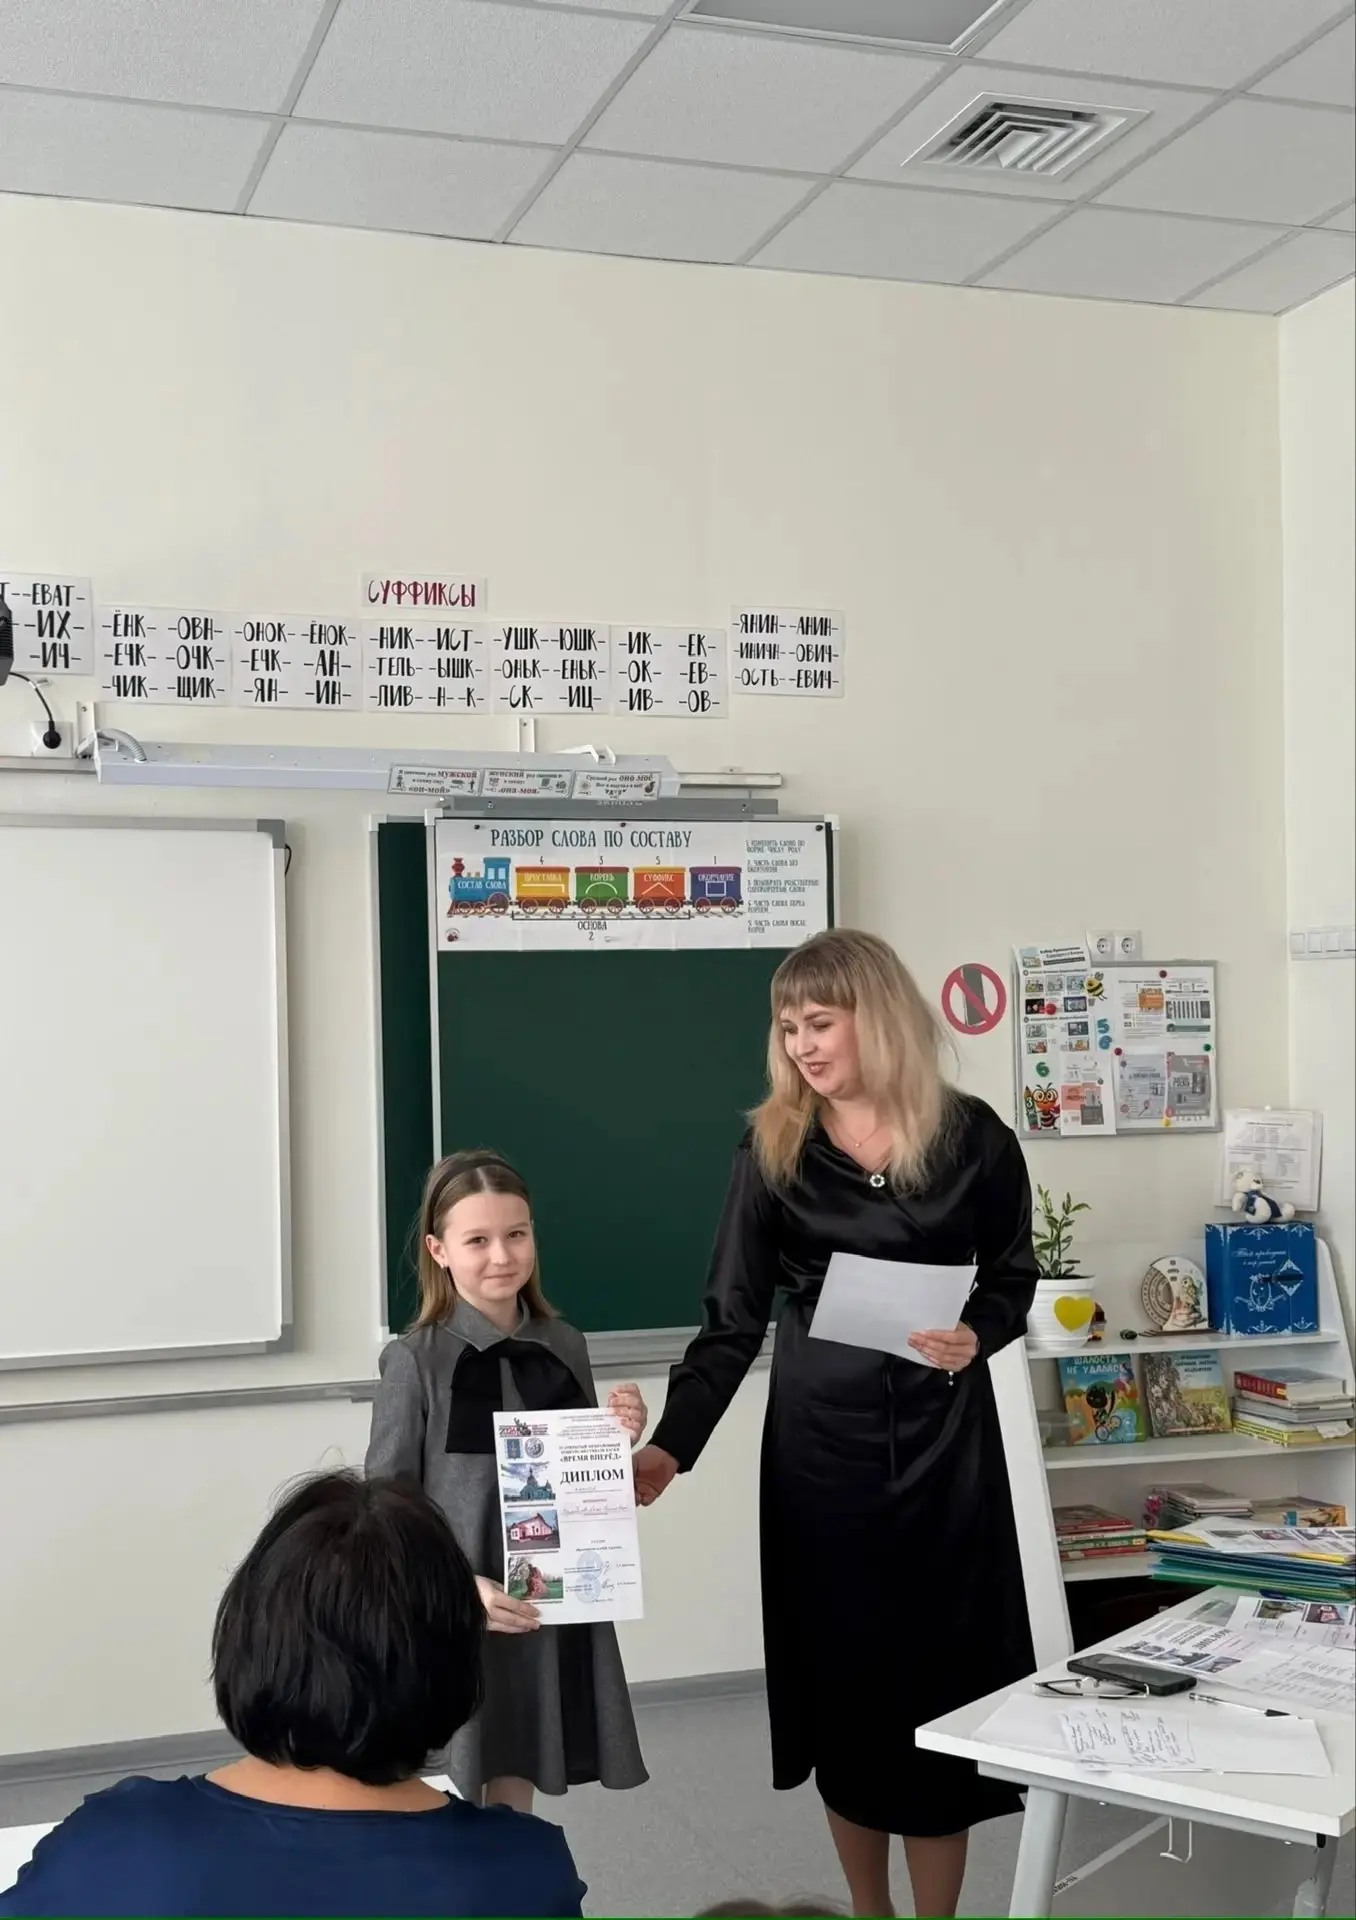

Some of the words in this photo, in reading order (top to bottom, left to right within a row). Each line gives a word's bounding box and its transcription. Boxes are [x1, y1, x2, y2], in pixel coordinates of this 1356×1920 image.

[368, 580, 476, 607] СУФФИКСЫ
[24, 609, 84, 640] -ИХ-
[168, 616, 223, 640] -ОВН-
[234, 622, 296, 643] -ОНОК-
[732, 613, 786, 634] -ЯНИН-
[789, 616, 839, 636] -АНИН-
[369, 626, 424, 650] -НИК-
[427, 627, 483, 651] -ИСТ-
[493, 626, 549, 650] -УШК-
[551, 628, 606, 652] -ЮШК-
[618, 631, 662, 655] -ИК-
[678, 633, 716, 657] -ЕК-
[29, 642, 82, 668] -ИЧ-
[104, 643, 156, 667] -ЕЧК-
[165, 644, 225, 670] -ОЧК-
[240, 649, 291, 672] -ЕЧК-
[304, 649, 351, 677] -АН-
[788, 643, 839, 663] -ОВИЧ-
[369, 657, 423, 676] -ТЕЛЬ-
[429, 657, 483, 679] -ЫШК-
[494, 659, 549, 679] -ОНЬК-
[553, 659, 606, 680] -ЕНЬК-
[618, 660, 662, 683] -ОК-
[680, 661, 717, 684] -ЕВ-
[734, 668, 785, 687] -ОСТЬ-
[788, 669, 839, 689] -ЕВИЧ-
[102, 675, 158, 698] -ЧИК-
[167, 676, 225, 701] -ЩИК-
[243, 677, 288, 702] -ЯН-
[305, 680, 351, 705] -ИН-
[369, 685, 423, 707] -ЛИВ-
[500, 684, 543, 709] -СК-
[559, 685, 602, 711] -ИЦ-
[619, 688, 663, 711] -ИВ-
[679, 689, 720, 713] -ОВ-
[490, 829, 544, 847] РАЗБОР
[552, 830, 596, 847] СЛОВА
[604, 830, 623, 847] ПО
[630, 830, 692, 848] СОСТАВУ
[539, 855, 544, 865] 4
[599, 855, 604, 865] 3
[656, 855, 661, 865] 5
[457, 880, 482, 889] СОСТАВ
[485, 880, 507, 889] СЛОВА
[590, 873, 615, 882] КОРЕНЬ
[643, 873, 675, 882] СУФФИКС
[577, 920, 607, 931] ОСНОВА
[588, 932, 594, 941] 2
[1035, 1061, 1050, 1077] 6
[1026, 1097, 1033, 1107] 3
[560, 1468, 624, 1485] ДИПЛОМ
